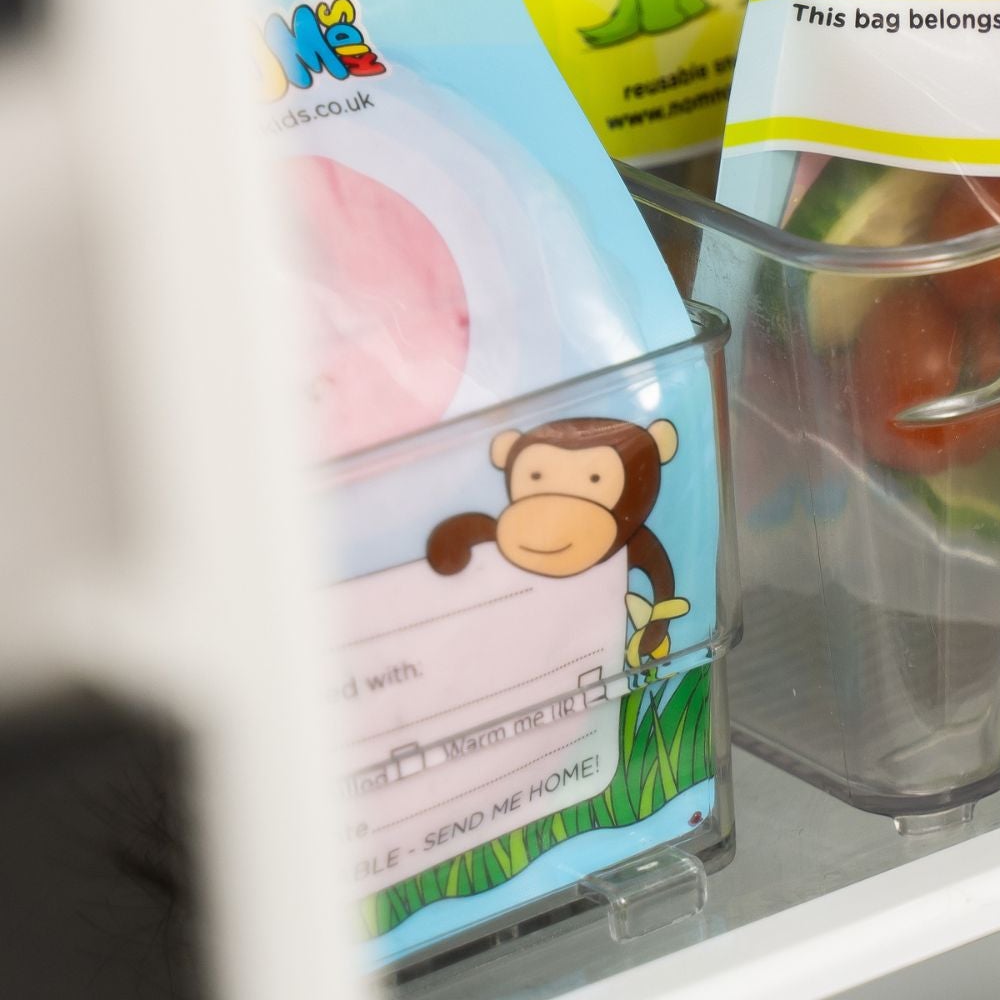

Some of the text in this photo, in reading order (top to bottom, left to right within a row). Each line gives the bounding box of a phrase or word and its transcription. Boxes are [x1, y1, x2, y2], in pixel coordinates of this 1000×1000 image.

[792, 3, 846, 29] This
[854, 8, 900, 33] bag
[424, 812, 485, 852] SEND
[491, 790, 523, 821] ME
[529, 754, 601, 802] HOME!
